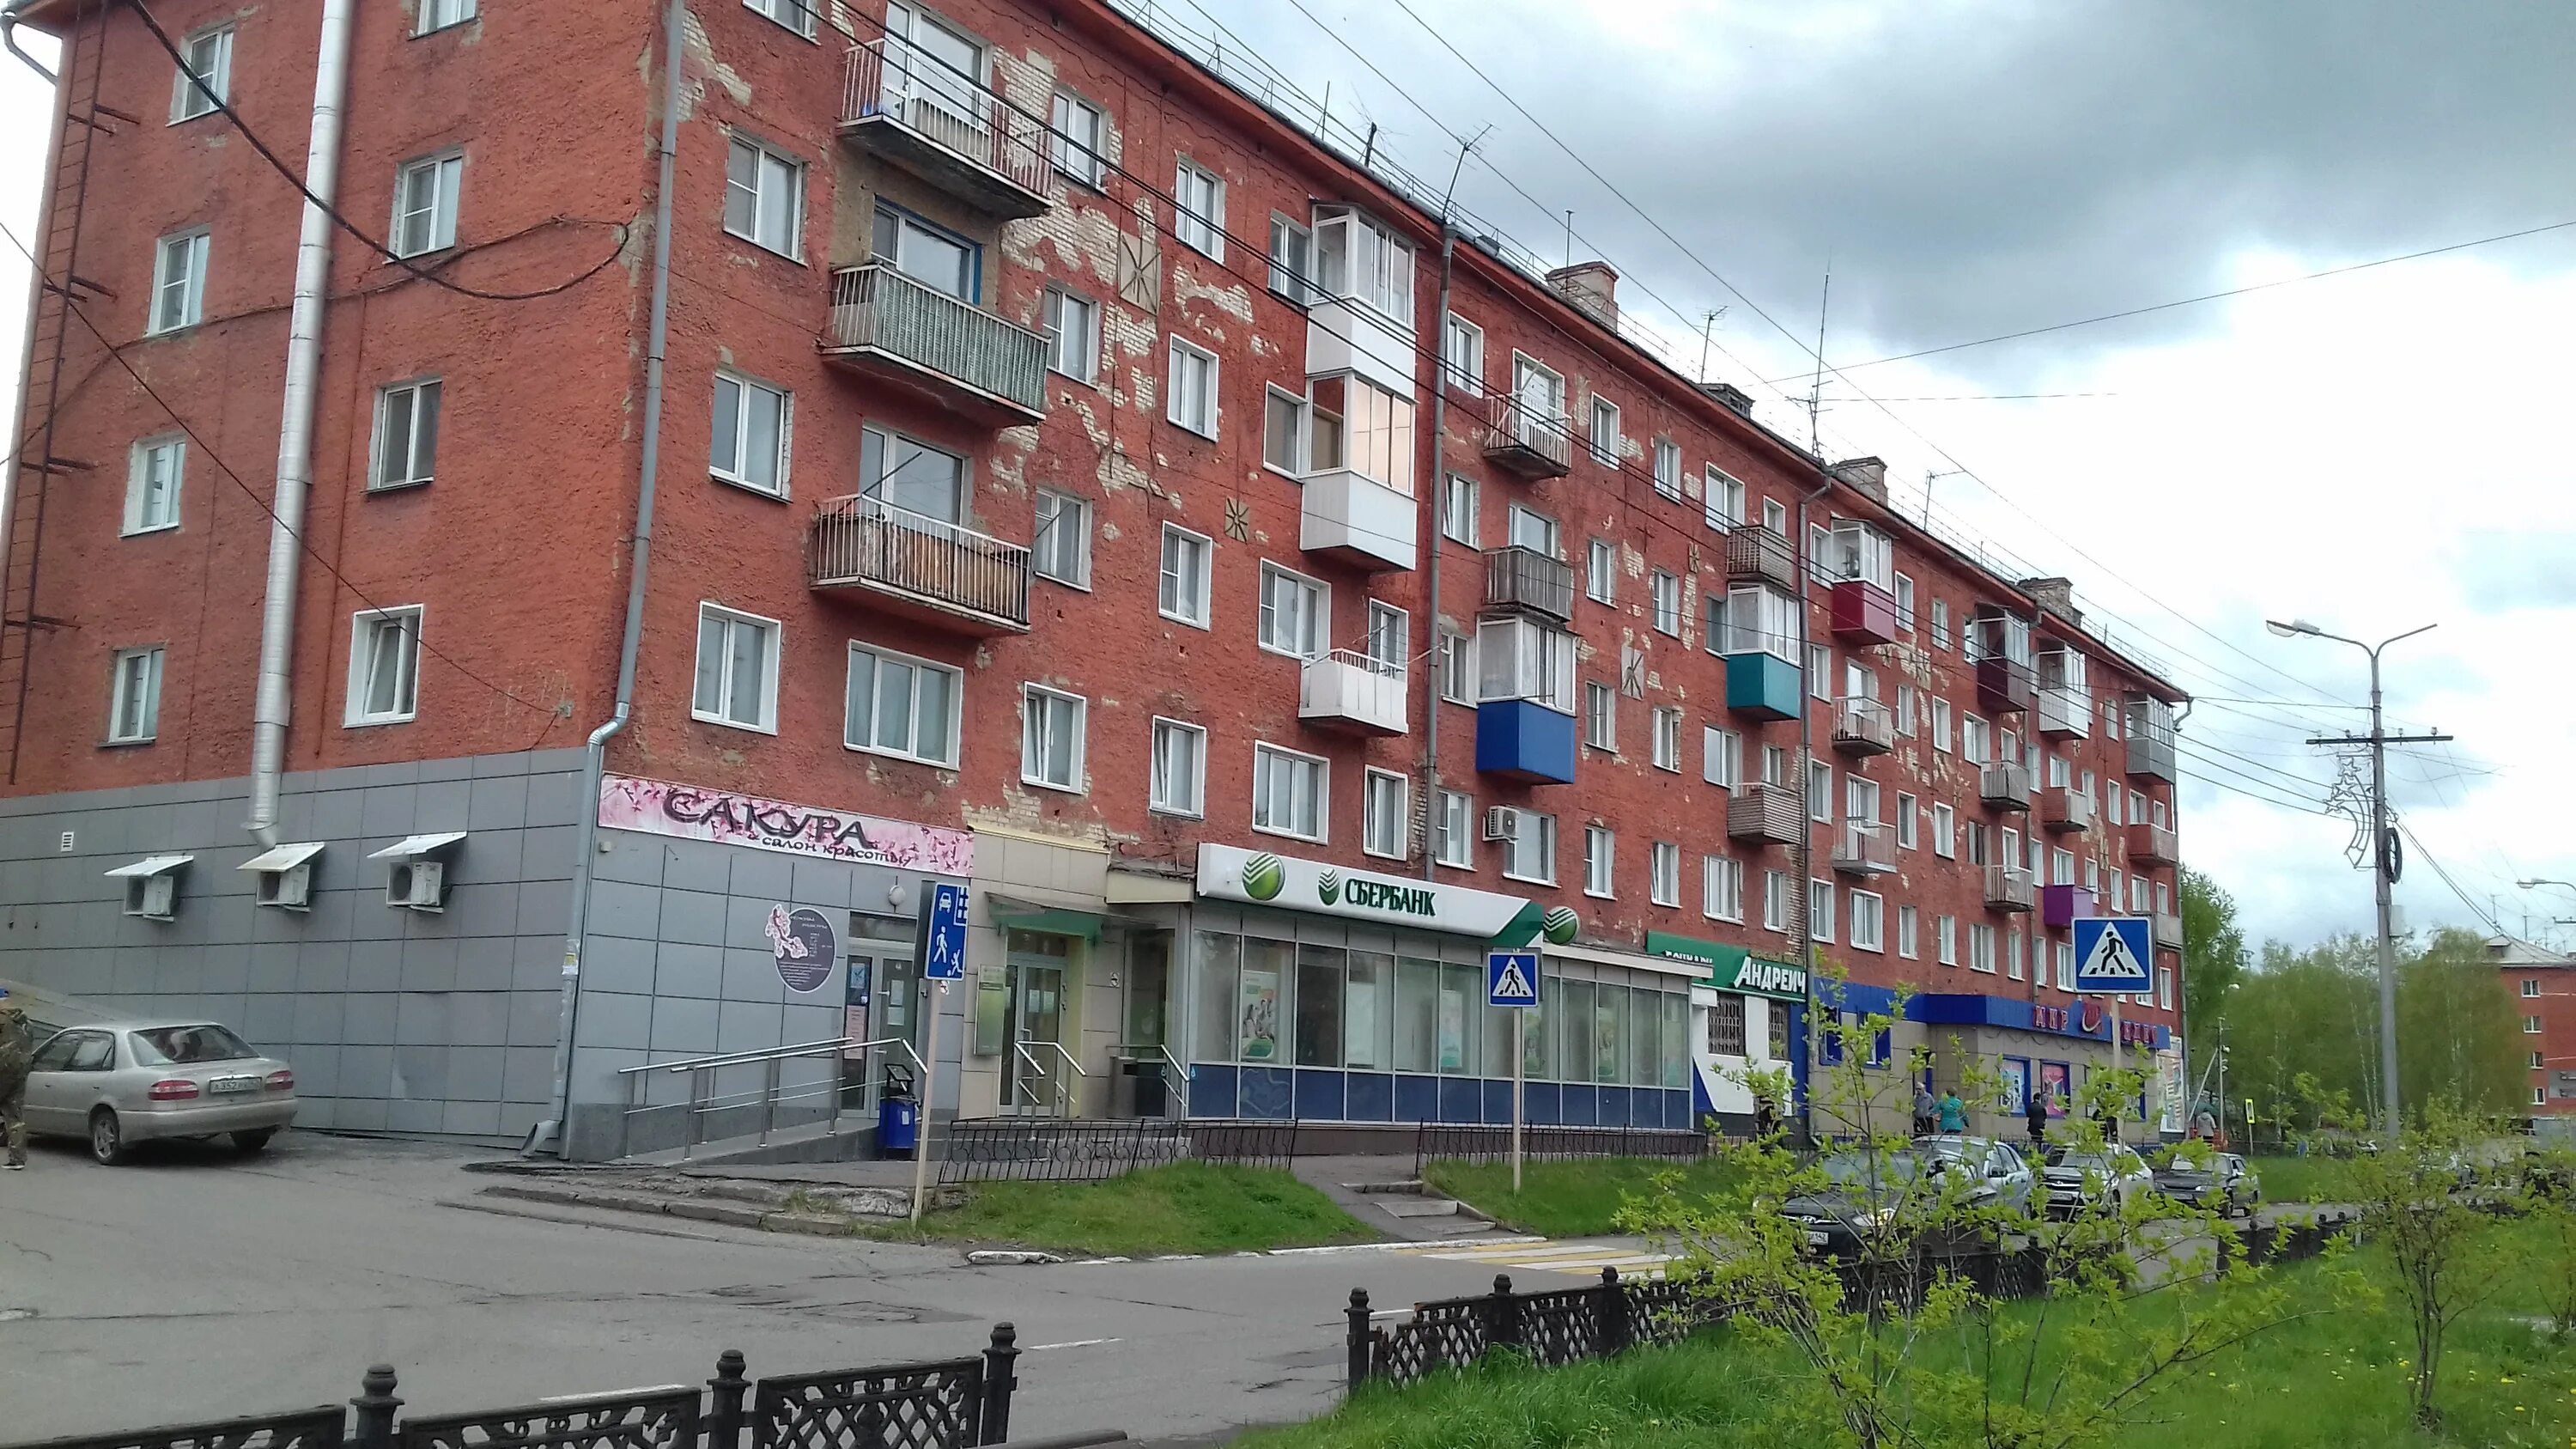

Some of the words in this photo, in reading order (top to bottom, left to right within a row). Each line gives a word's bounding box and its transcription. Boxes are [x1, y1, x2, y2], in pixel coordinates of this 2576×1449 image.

[662, 792, 878, 849] САКУРА
[762, 836, 817, 852] салон
[823, 844, 913, 868] красоты
[1345, 878, 1437, 916] СБЕРБАНК
